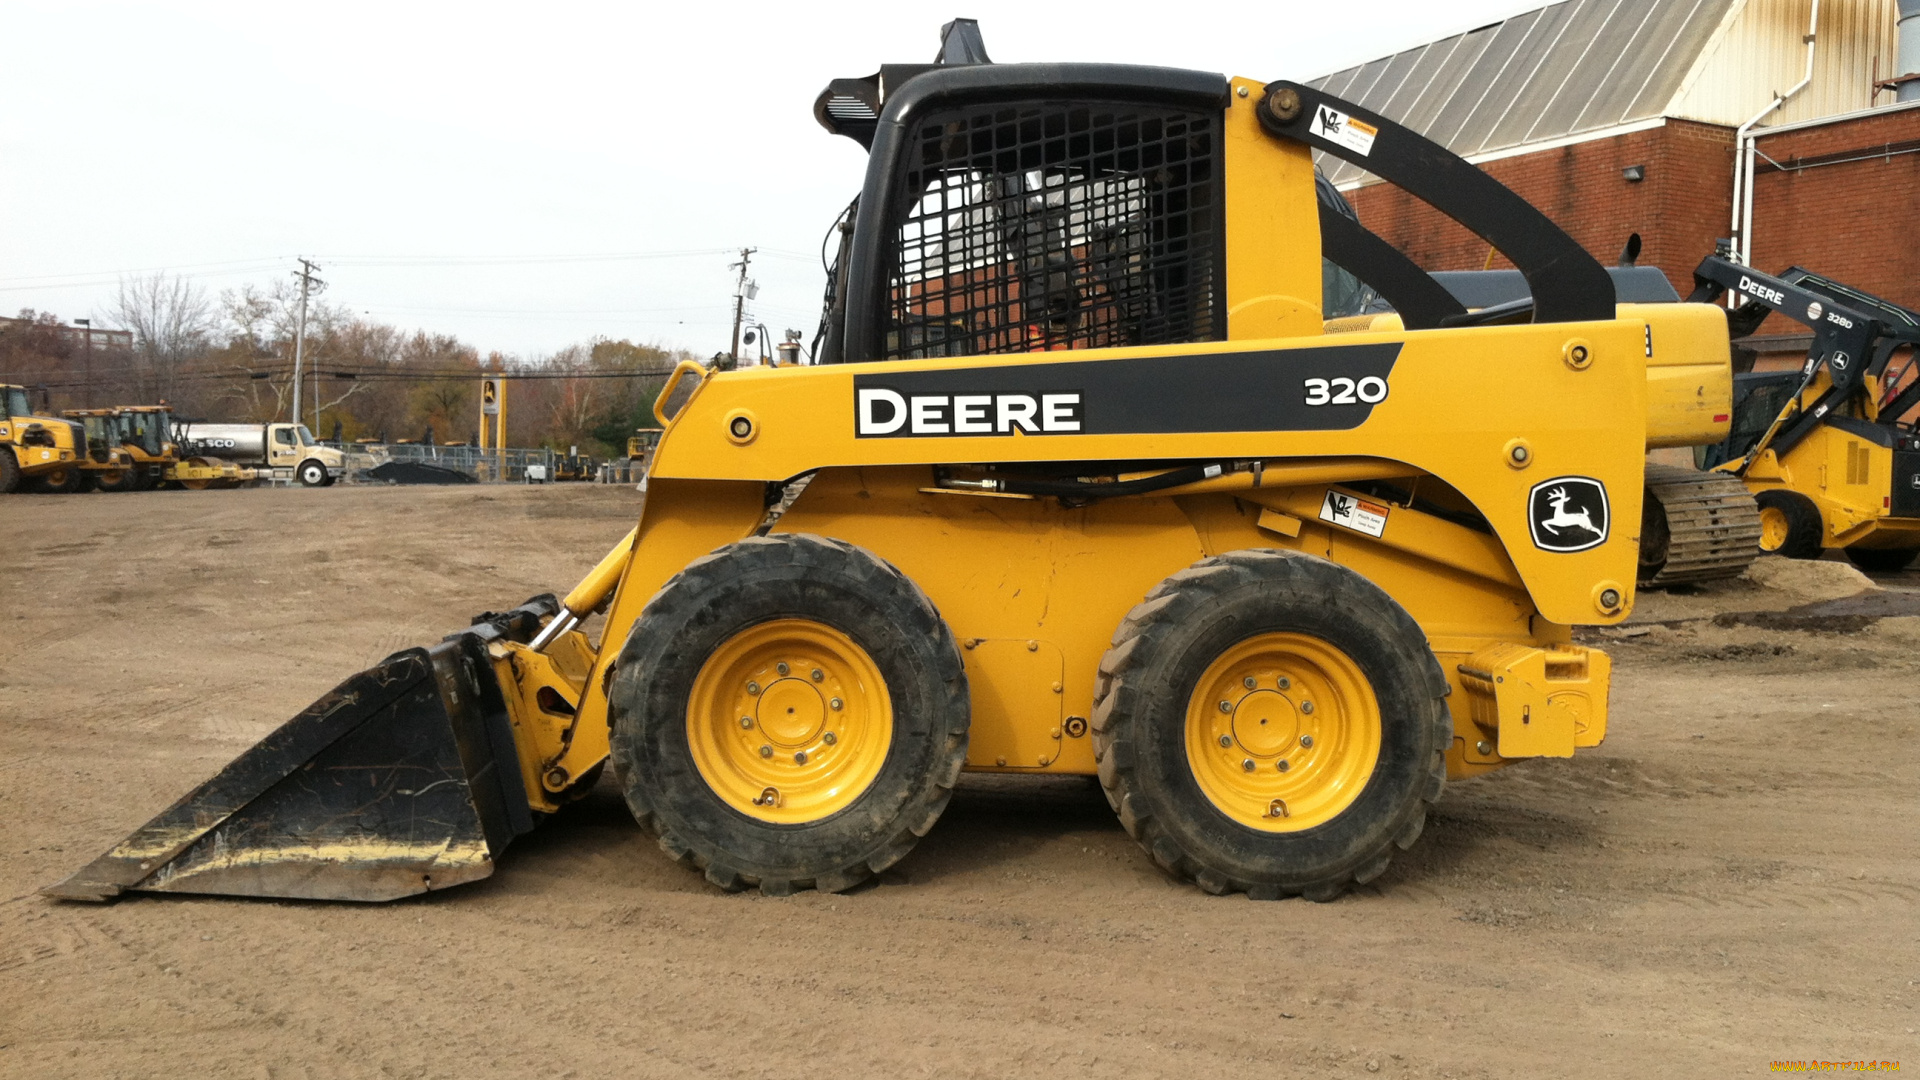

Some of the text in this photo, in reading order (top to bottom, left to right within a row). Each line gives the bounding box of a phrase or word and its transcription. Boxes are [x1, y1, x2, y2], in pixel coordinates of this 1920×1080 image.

[1739, 275, 1785, 306] DEERE
[1826, 312, 1853, 329] 328D
[1304, 376, 1387, 406] 320
[858, 388, 1081, 435] DEERE
